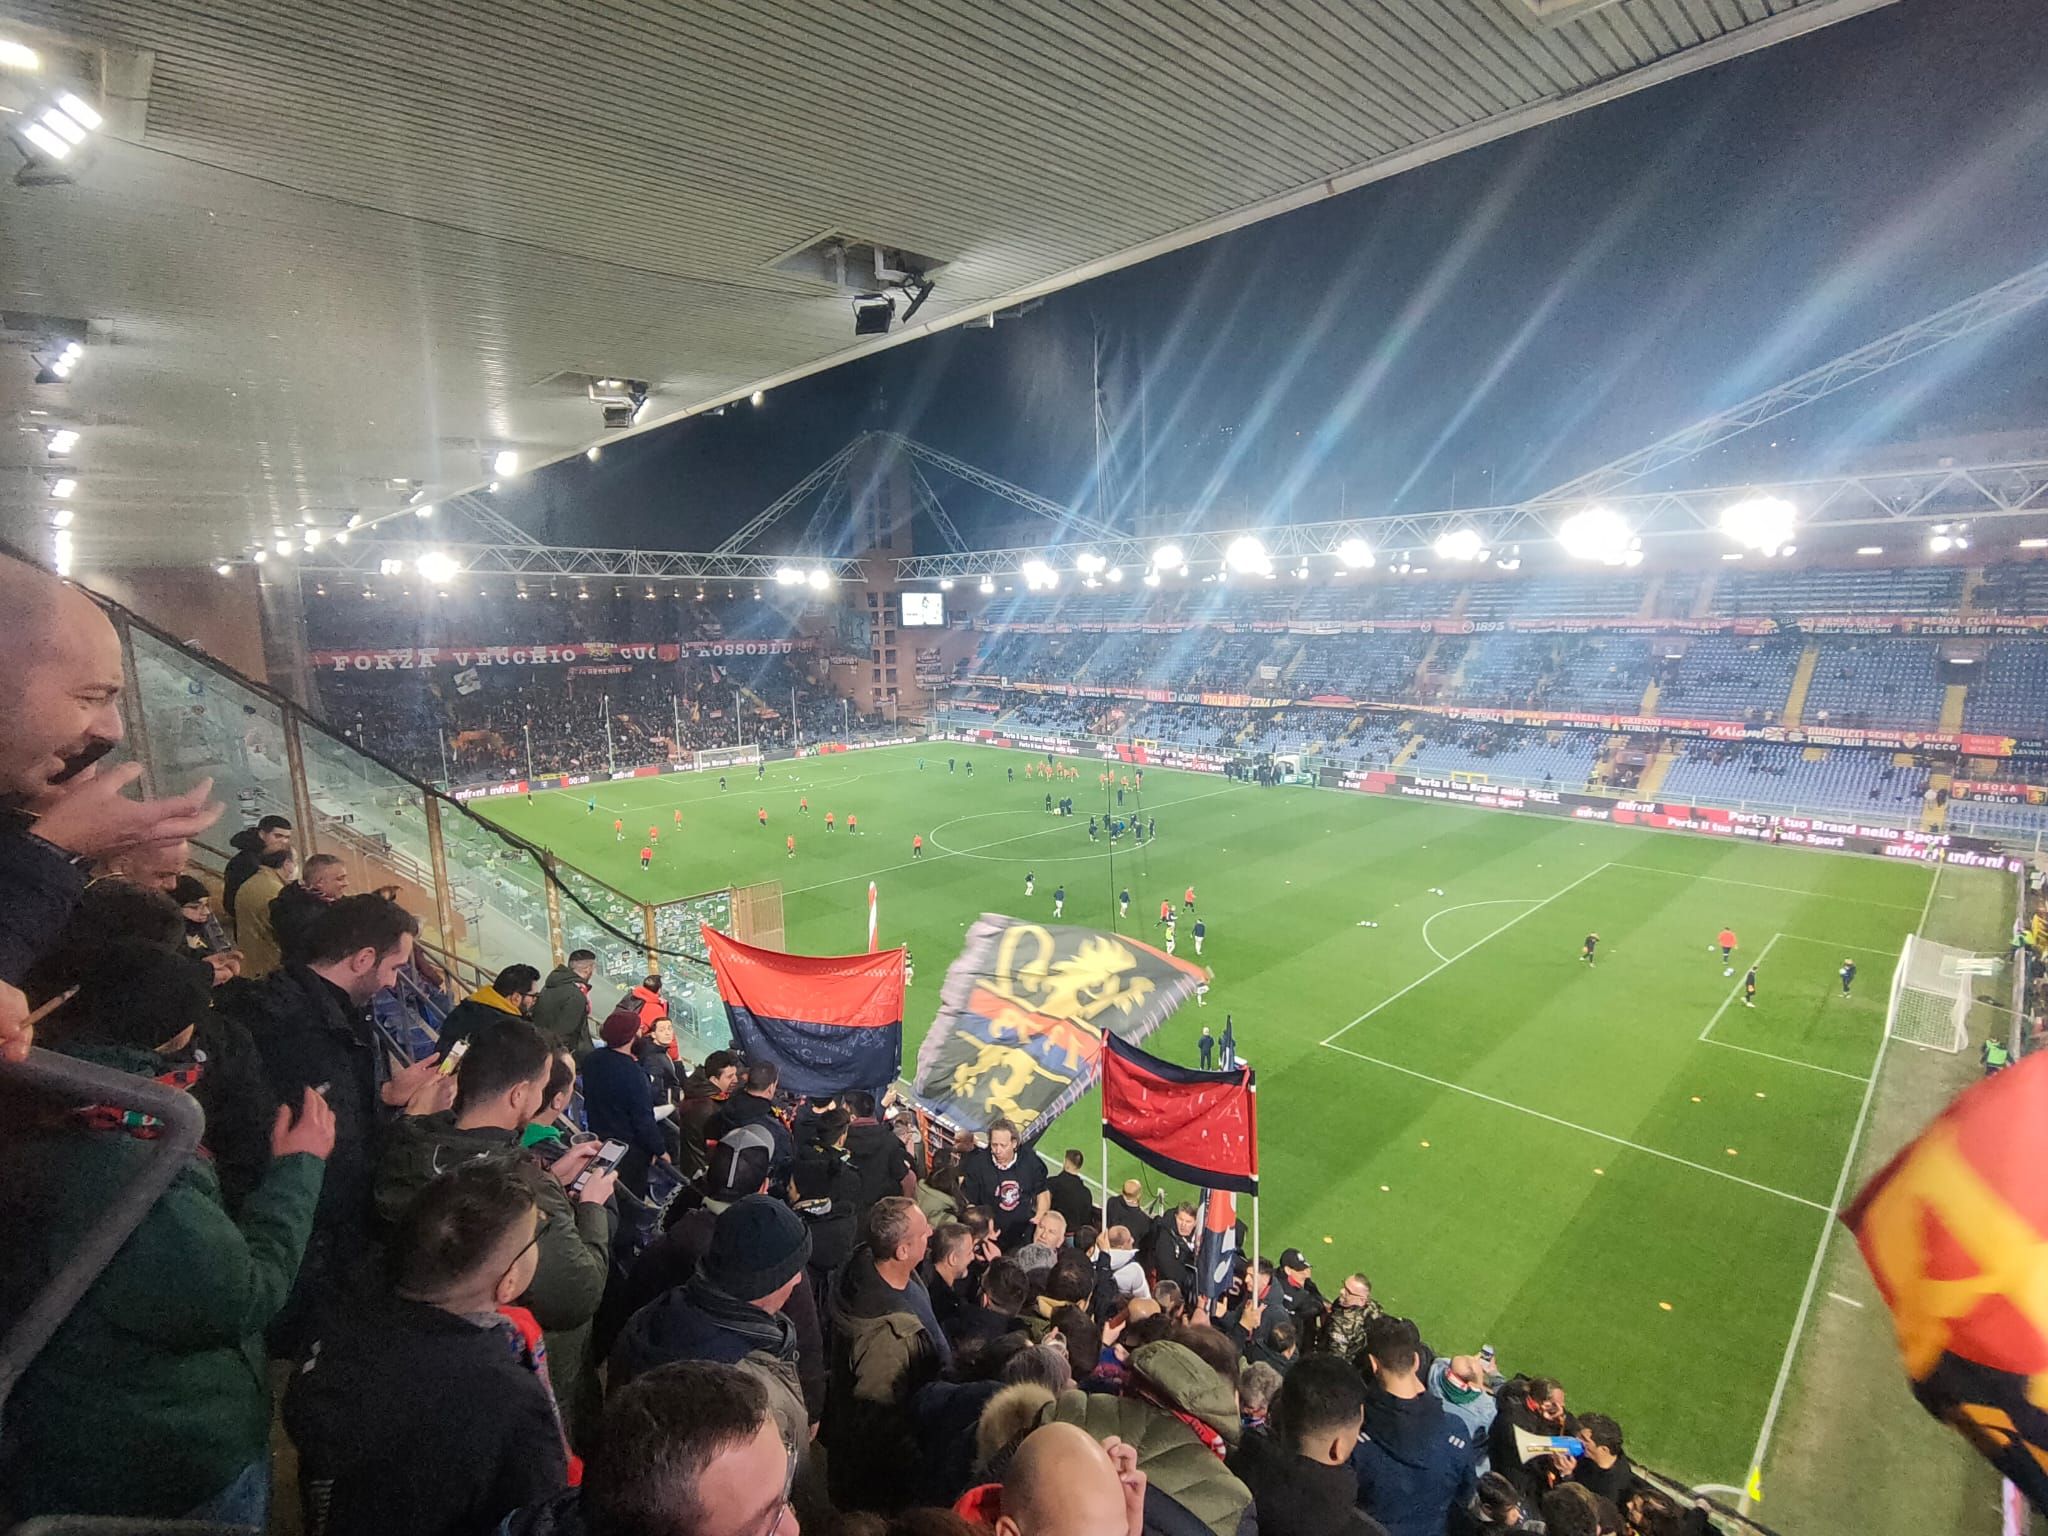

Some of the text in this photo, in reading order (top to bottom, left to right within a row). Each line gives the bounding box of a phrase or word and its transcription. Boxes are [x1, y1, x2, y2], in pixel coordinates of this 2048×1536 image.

[1922, 617, 1960, 625] GENOA
[1921, 626, 1960, 634] ELSAG
[1996, 627, 2029, 635] PIEVE
[332, 651, 437, 672] FORZA
[453, 648, 576, 667] VECCHIO
[1622, 724, 1660, 733] TORINO
[1712, 724, 1766, 740] Miami
[1924, 733, 1955, 742] CLUB
[1867, 740, 1901, 749] SERRA
[1215, 755, 1234, 764] Sport
[673, 763, 692, 772] Porta
[568, 775, 590, 785] 00:00
[1414, 777, 1441, 788] Porta
[1451, 781, 1467, 791] tuo
[1469, 781, 1499, 793] Brand
[1500, 786, 1525, 798] nello
[1528, 788, 1559, 803] Sport
[1976, 783, 2018, 792] ISOLA
[1402, 786, 1424, 796] Porta
[1433, 789, 1447, 799] tuo
[1448, 791, 1474, 802] Brand
[1498, 796, 1524, 809] Sport
[1973, 794, 2019, 804] GIGLIO
[1617, 800, 1656, 814] infront
[1667, 817, 1698, 830] Porta
[1712, 822, 1732, 834] tuo
[1805, 833, 1846, 848] Sport
[1782, 818, 1809, 831] tuo
[1812, 820, 1857, 835] Brand
[1859, 826, 1899, 842] nello
[1901, 831, 1951, 849] Sport
[1946, 850, 2005, 869] infront
